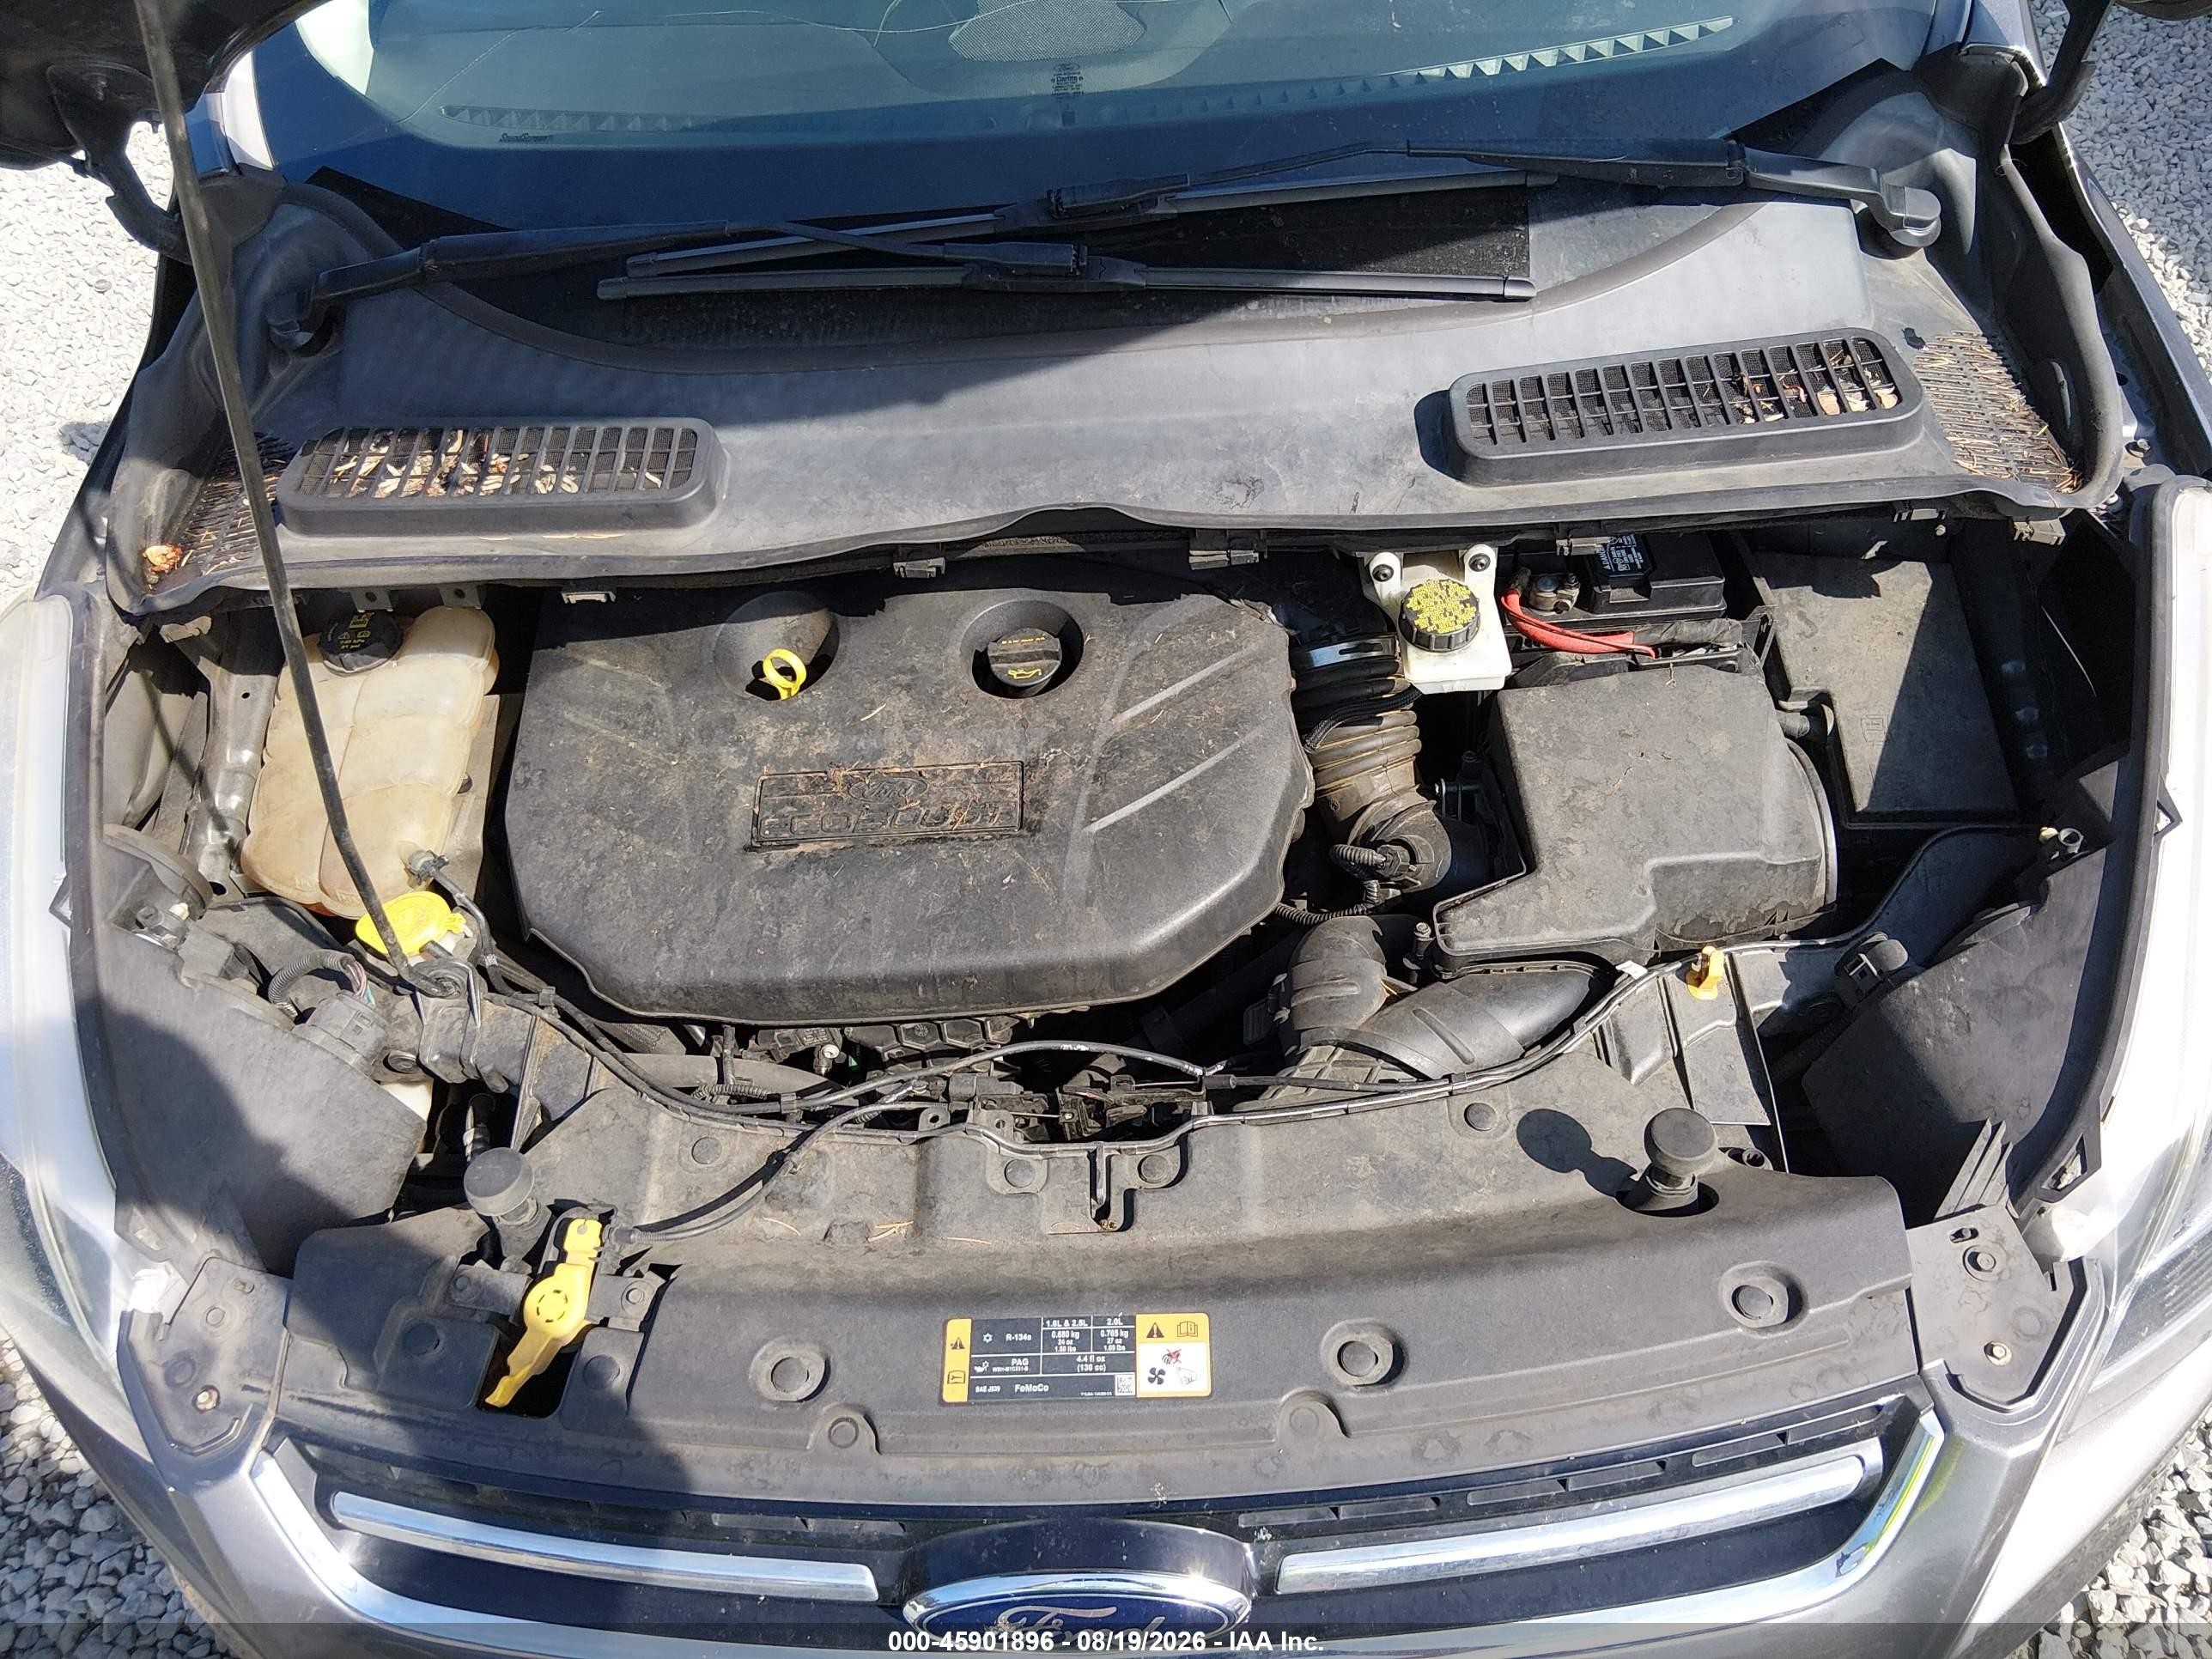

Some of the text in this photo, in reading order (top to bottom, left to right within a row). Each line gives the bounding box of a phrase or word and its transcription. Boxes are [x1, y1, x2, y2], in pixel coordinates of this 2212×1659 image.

[1006, 1333, 1032, 1341] R-134a
[1071, 1329, 1080, 1340] kg
[1120, 1328, 1129, 1339] kg
[1011, 1358, 1030, 1366] PAG
[1077, 1364, 1093, 1373] (130
[1014, 1382, 1050, 1393] FoMoCo
